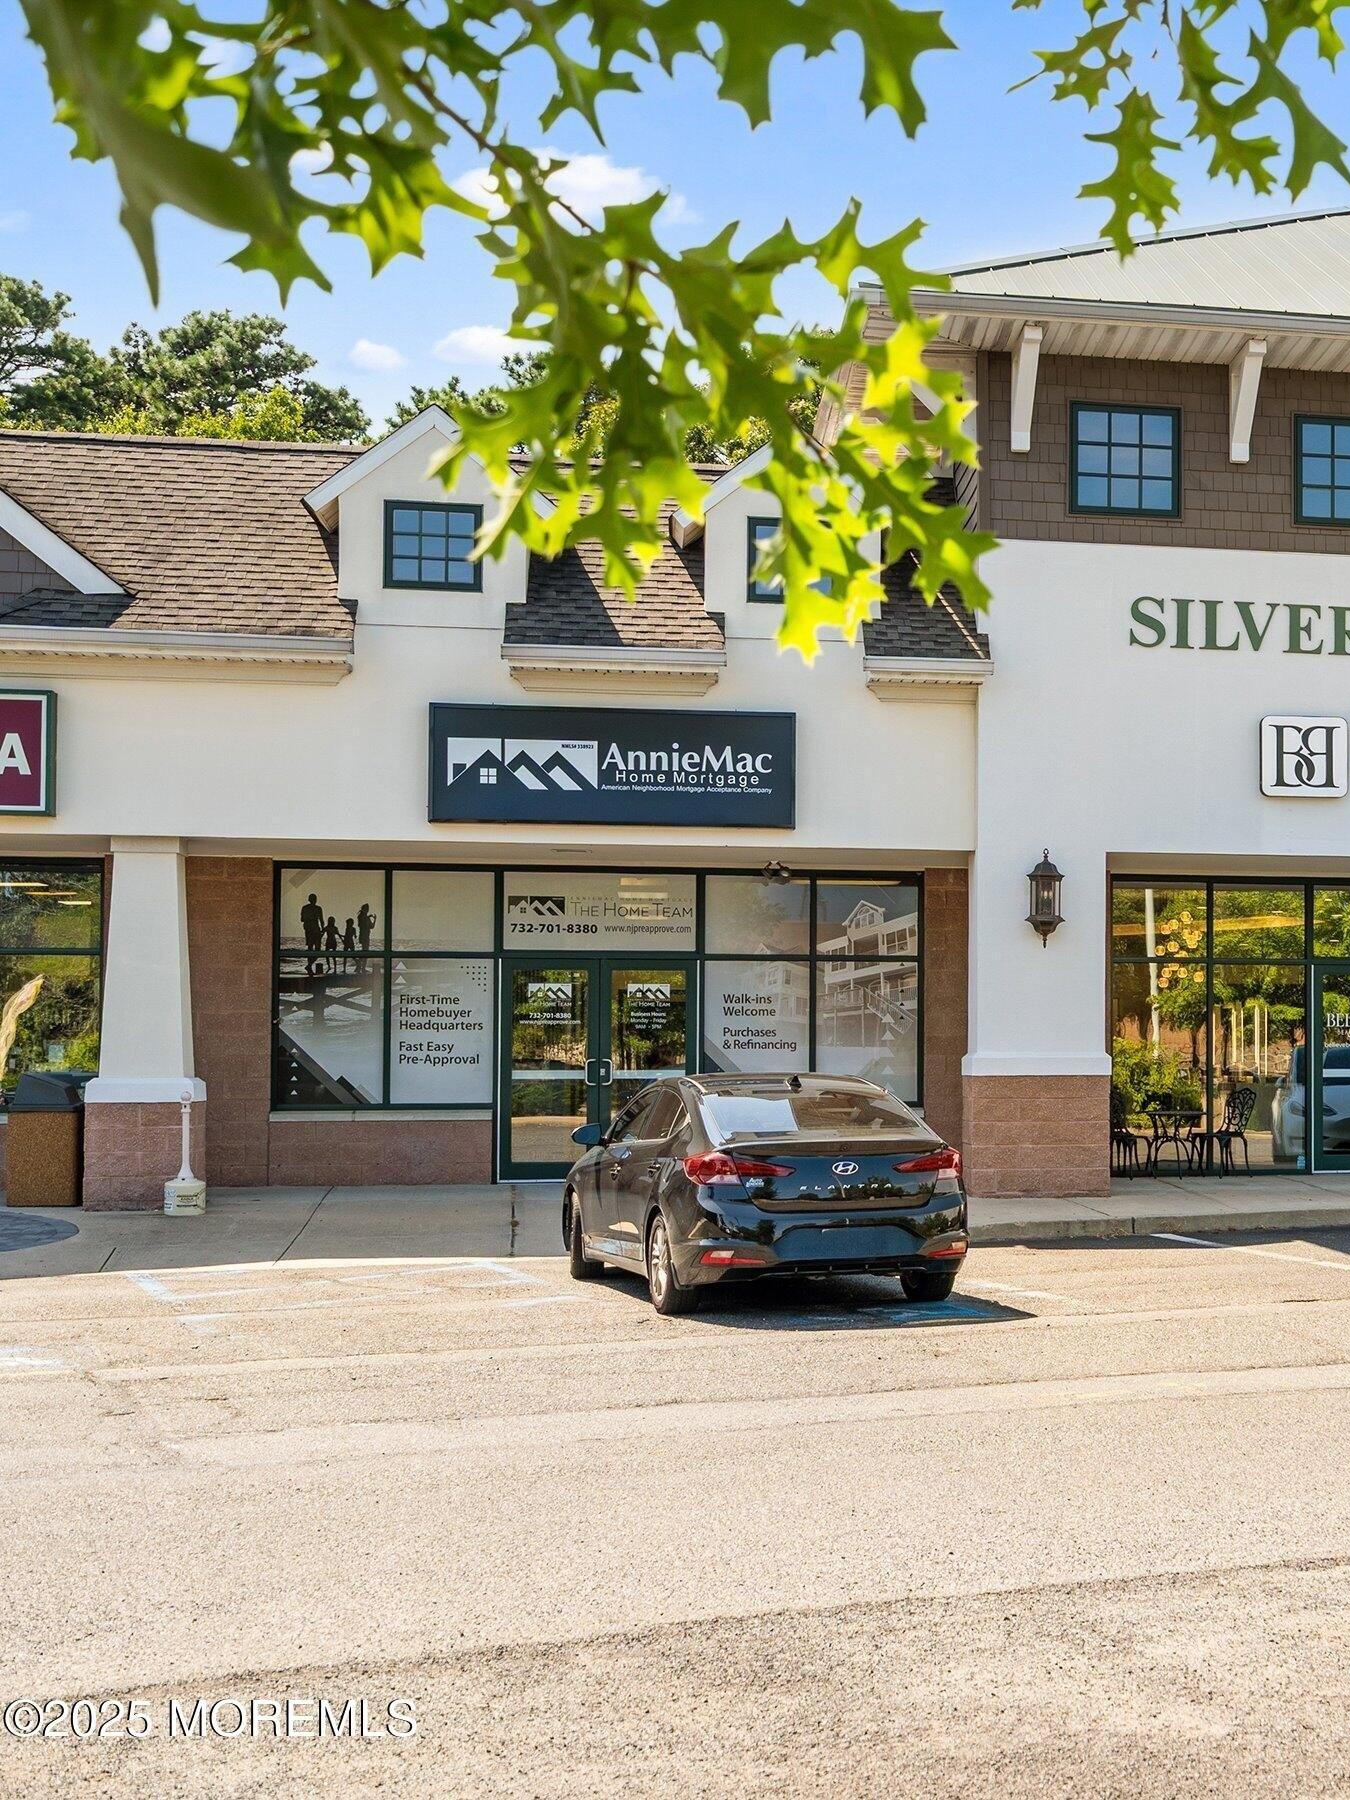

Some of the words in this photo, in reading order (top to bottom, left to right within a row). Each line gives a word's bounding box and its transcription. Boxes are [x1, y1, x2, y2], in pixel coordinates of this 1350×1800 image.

[601, 742, 773, 774] AnnieMac
[615, 770, 666, 784] Home
[673, 771, 760, 787] Mortgage
[632, 784, 675, 793] Neighborhood
[676, 785, 705, 793] Mortgage
[706, 786, 741, 794] Acceptance
[743, 786, 773, 795] Company
[570, 901, 599, 917] THE
[604, 902, 649, 918] HOME
[652, 902, 693, 918] TEAM
[510, 923, 598, 934] 732-701-8380
[604, 923, 692, 935] www.njpreapprove.com
[400, 994, 460, 1005] First-Time
[723, 993, 772, 1004] Walk-ins
[399, 1006, 472, 1020] Homebuyer
[723, 1006, 776, 1017] Welcome
[399, 1019, 484, 1032] Headquarters
[723, 1026, 777, 1037] Purchases
[399, 1041, 424, 1052] Fast
[427, 1041, 455, 1054] Easy
[722, 1039, 732, 1050] &
[733, 1039, 797, 1052] Refinancing
[399, 1053, 480, 1066] Pre-Approval
[799, 1183, 893, 1191] ELANTRA
